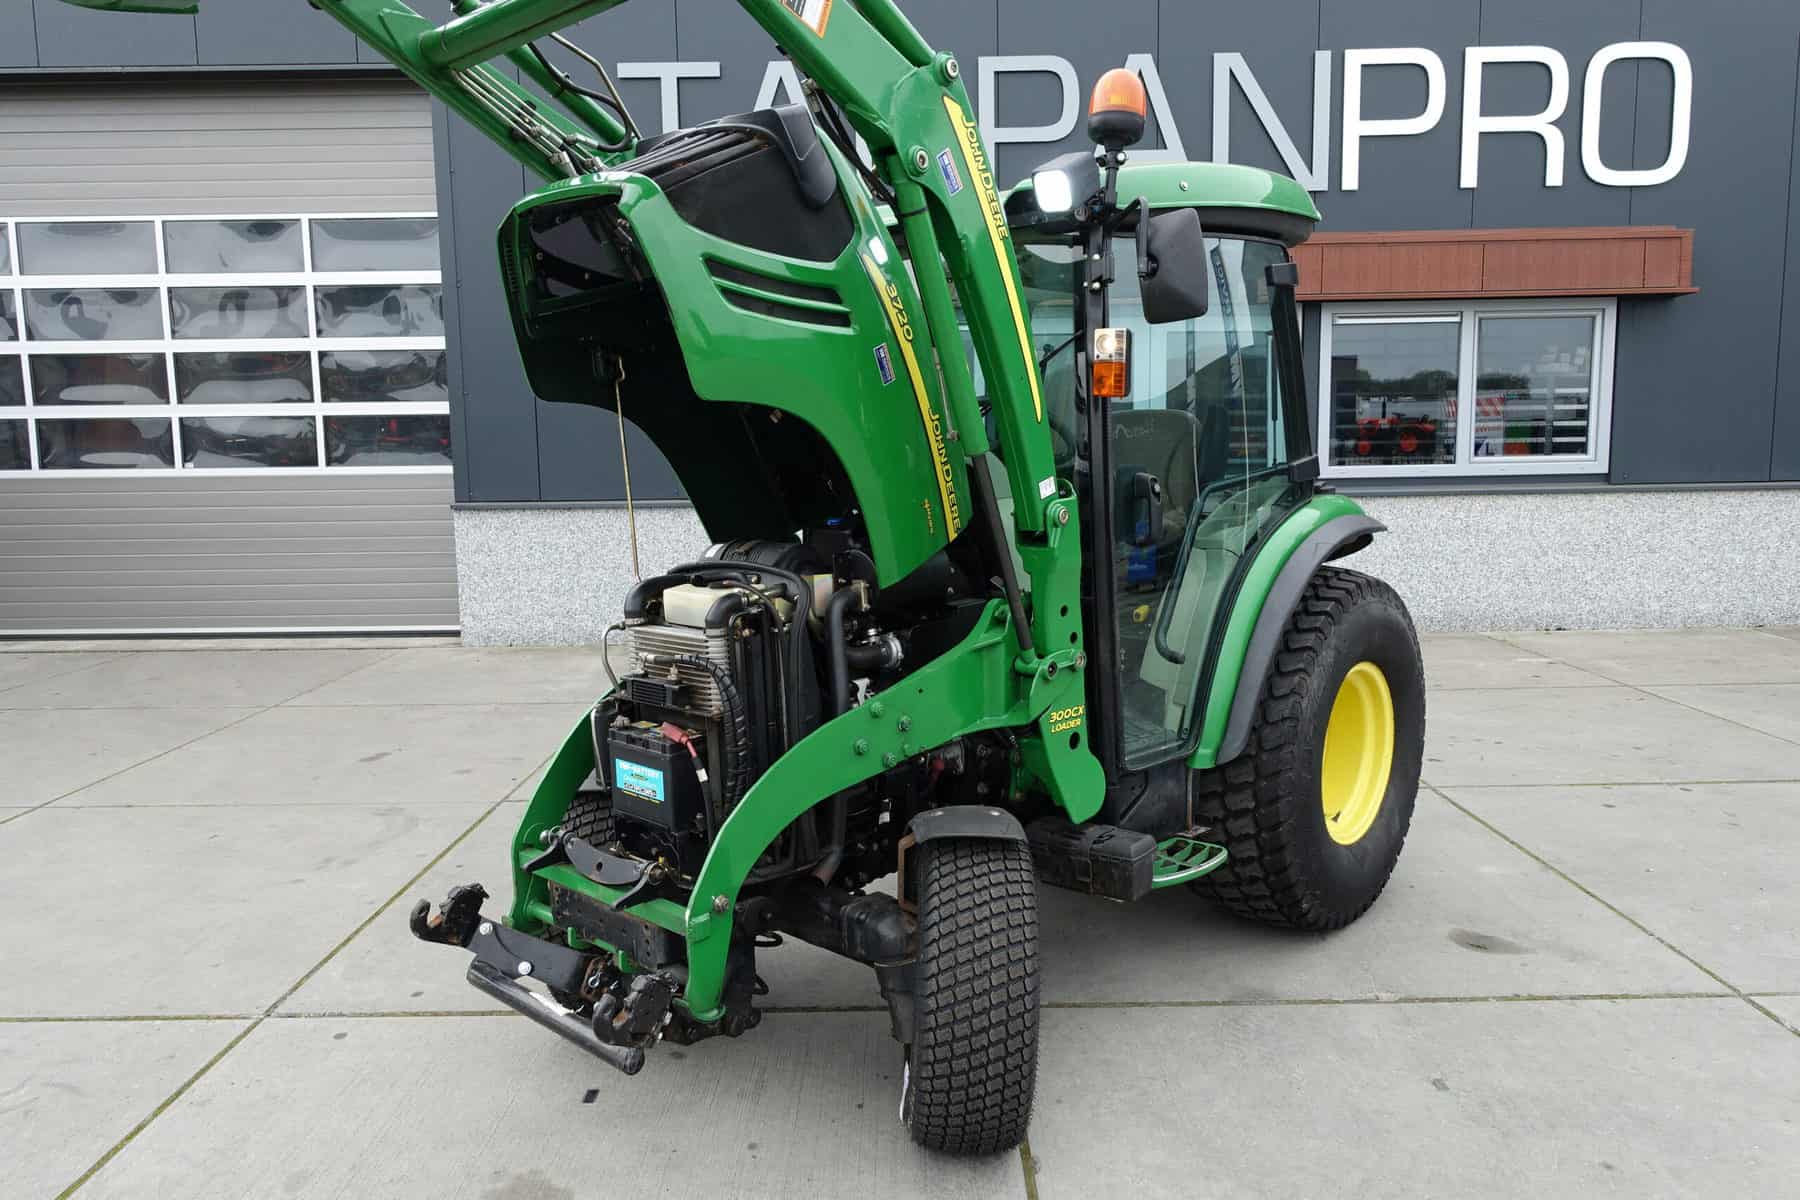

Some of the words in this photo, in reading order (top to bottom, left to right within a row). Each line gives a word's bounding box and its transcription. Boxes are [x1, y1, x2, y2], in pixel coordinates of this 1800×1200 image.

[617, 41, 1693, 192] TPANPRO
[961, 115, 986, 171] JOHN
[981, 172, 1009, 240] DEERE
[886, 284, 913, 342] 3720
[929, 408, 948, 465] JOHN
[943, 466, 961, 532] DEERE
[1049, 704, 1085, 723] 300CX
[1051, 718, 1081, 733] LOADER
